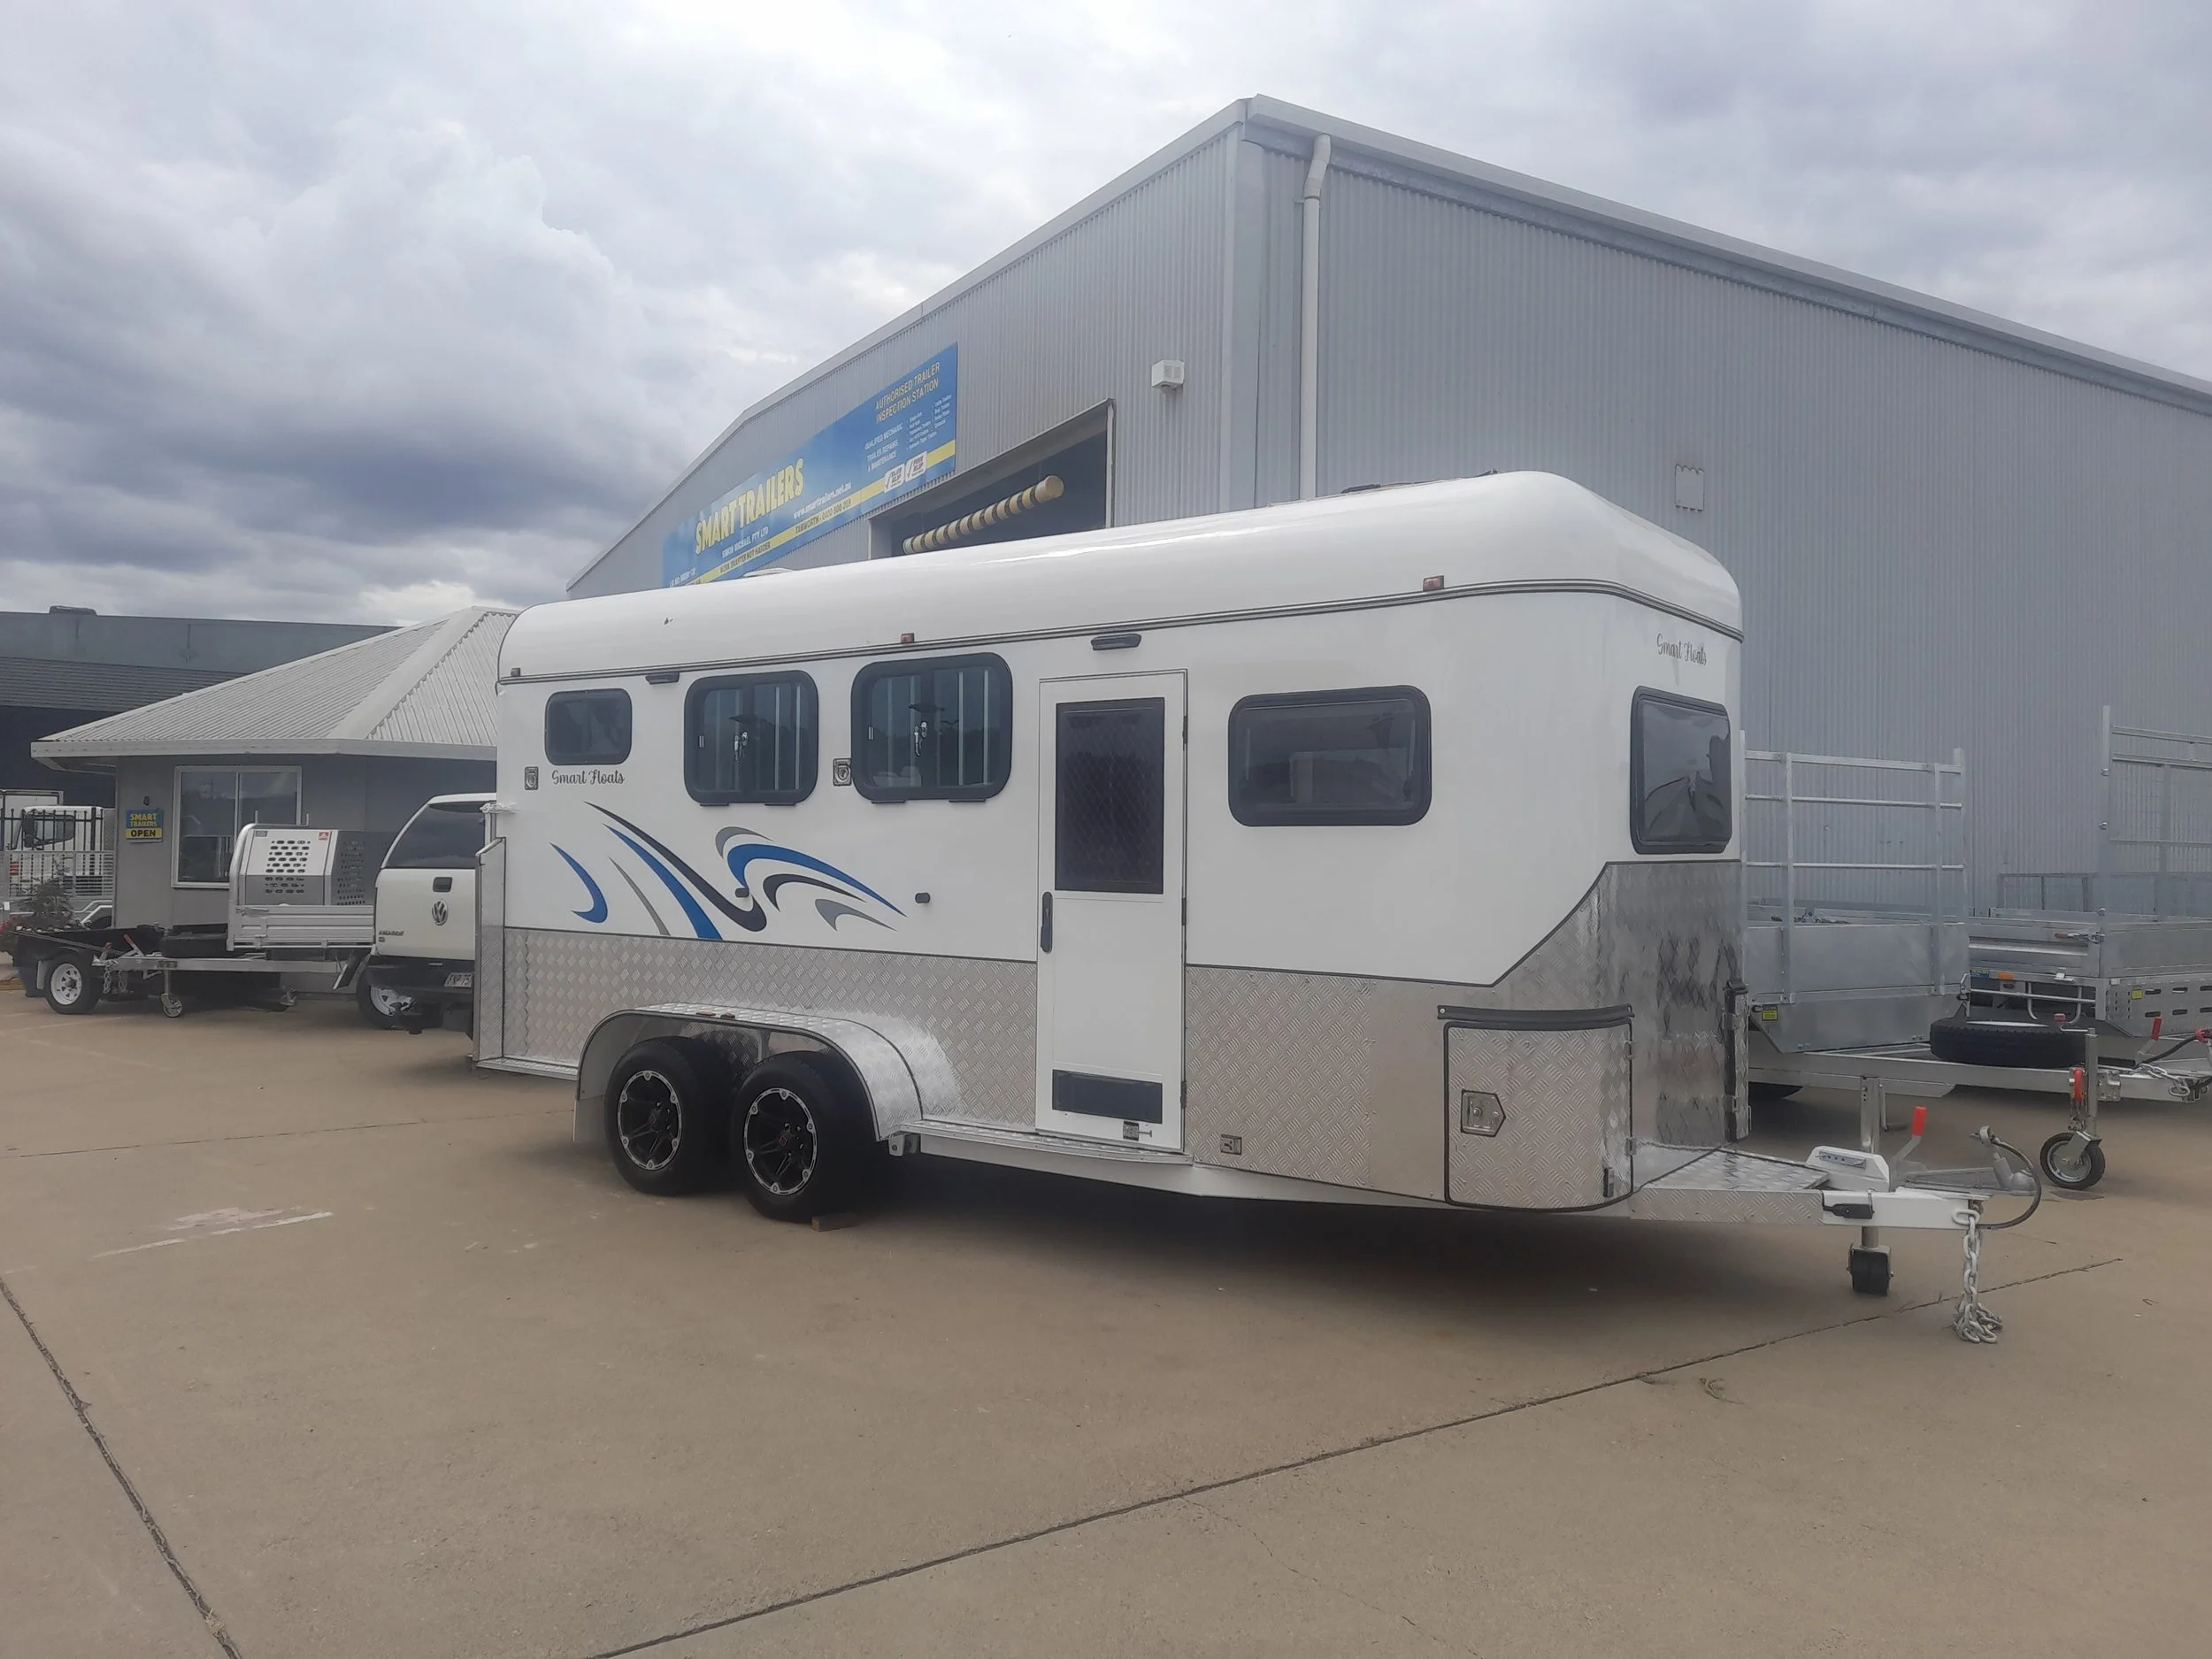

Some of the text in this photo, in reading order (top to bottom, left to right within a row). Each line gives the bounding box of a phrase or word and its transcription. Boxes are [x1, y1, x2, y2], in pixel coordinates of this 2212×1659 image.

[875, 379, 912, 410] AUTHORISED
[913, 361, 941, 386] TRAILER
[876, 397, 911, 424] INSPECTION
[912, 378, 939, 403] STATION
[695, 457, 804, 555] SMART TRAILERS
[751, 530, 760, 542] PTY
[760, 526, 769, 538] LTD
[1656, 633, 1708, 666] Smart Floats
[551, 769, 626, 786] Smart Floats
